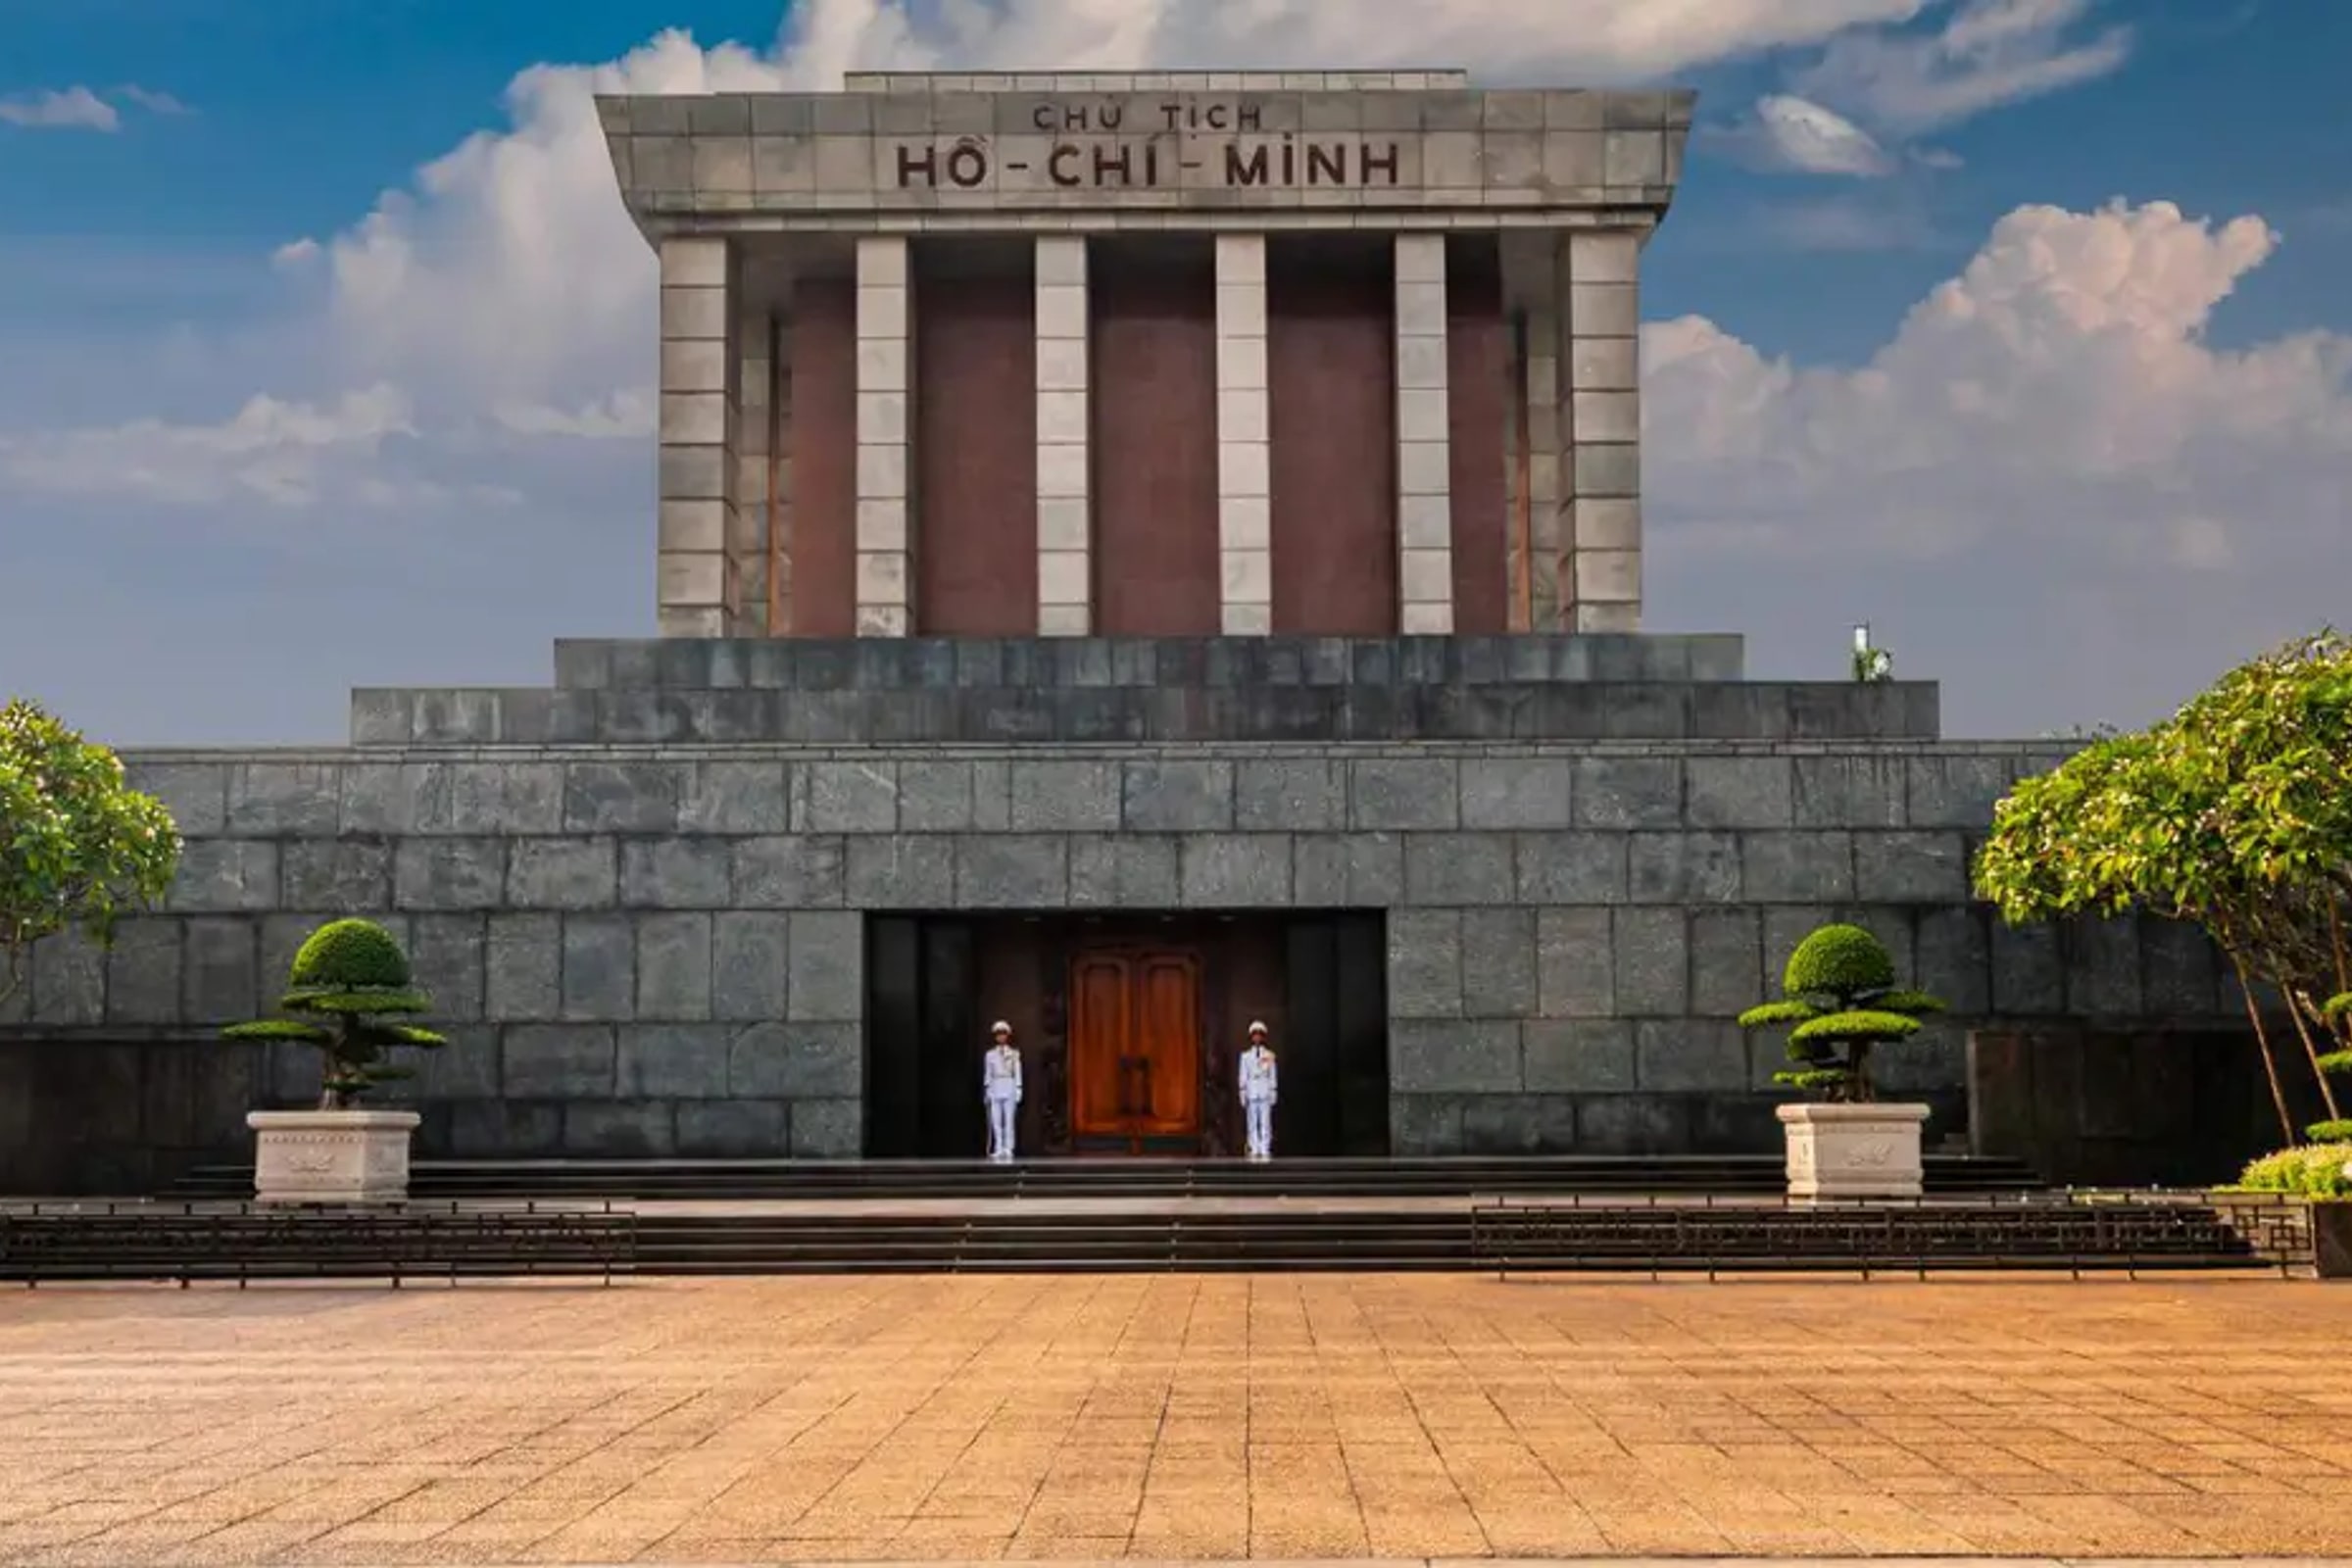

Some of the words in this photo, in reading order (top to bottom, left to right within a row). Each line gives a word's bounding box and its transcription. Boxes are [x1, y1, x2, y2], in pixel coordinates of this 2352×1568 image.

[1033, 94, 1122, 130] CHỦ
[897, 135, 987, 187] HỒ
[1048, 132, 1163, 186] CHÍ
